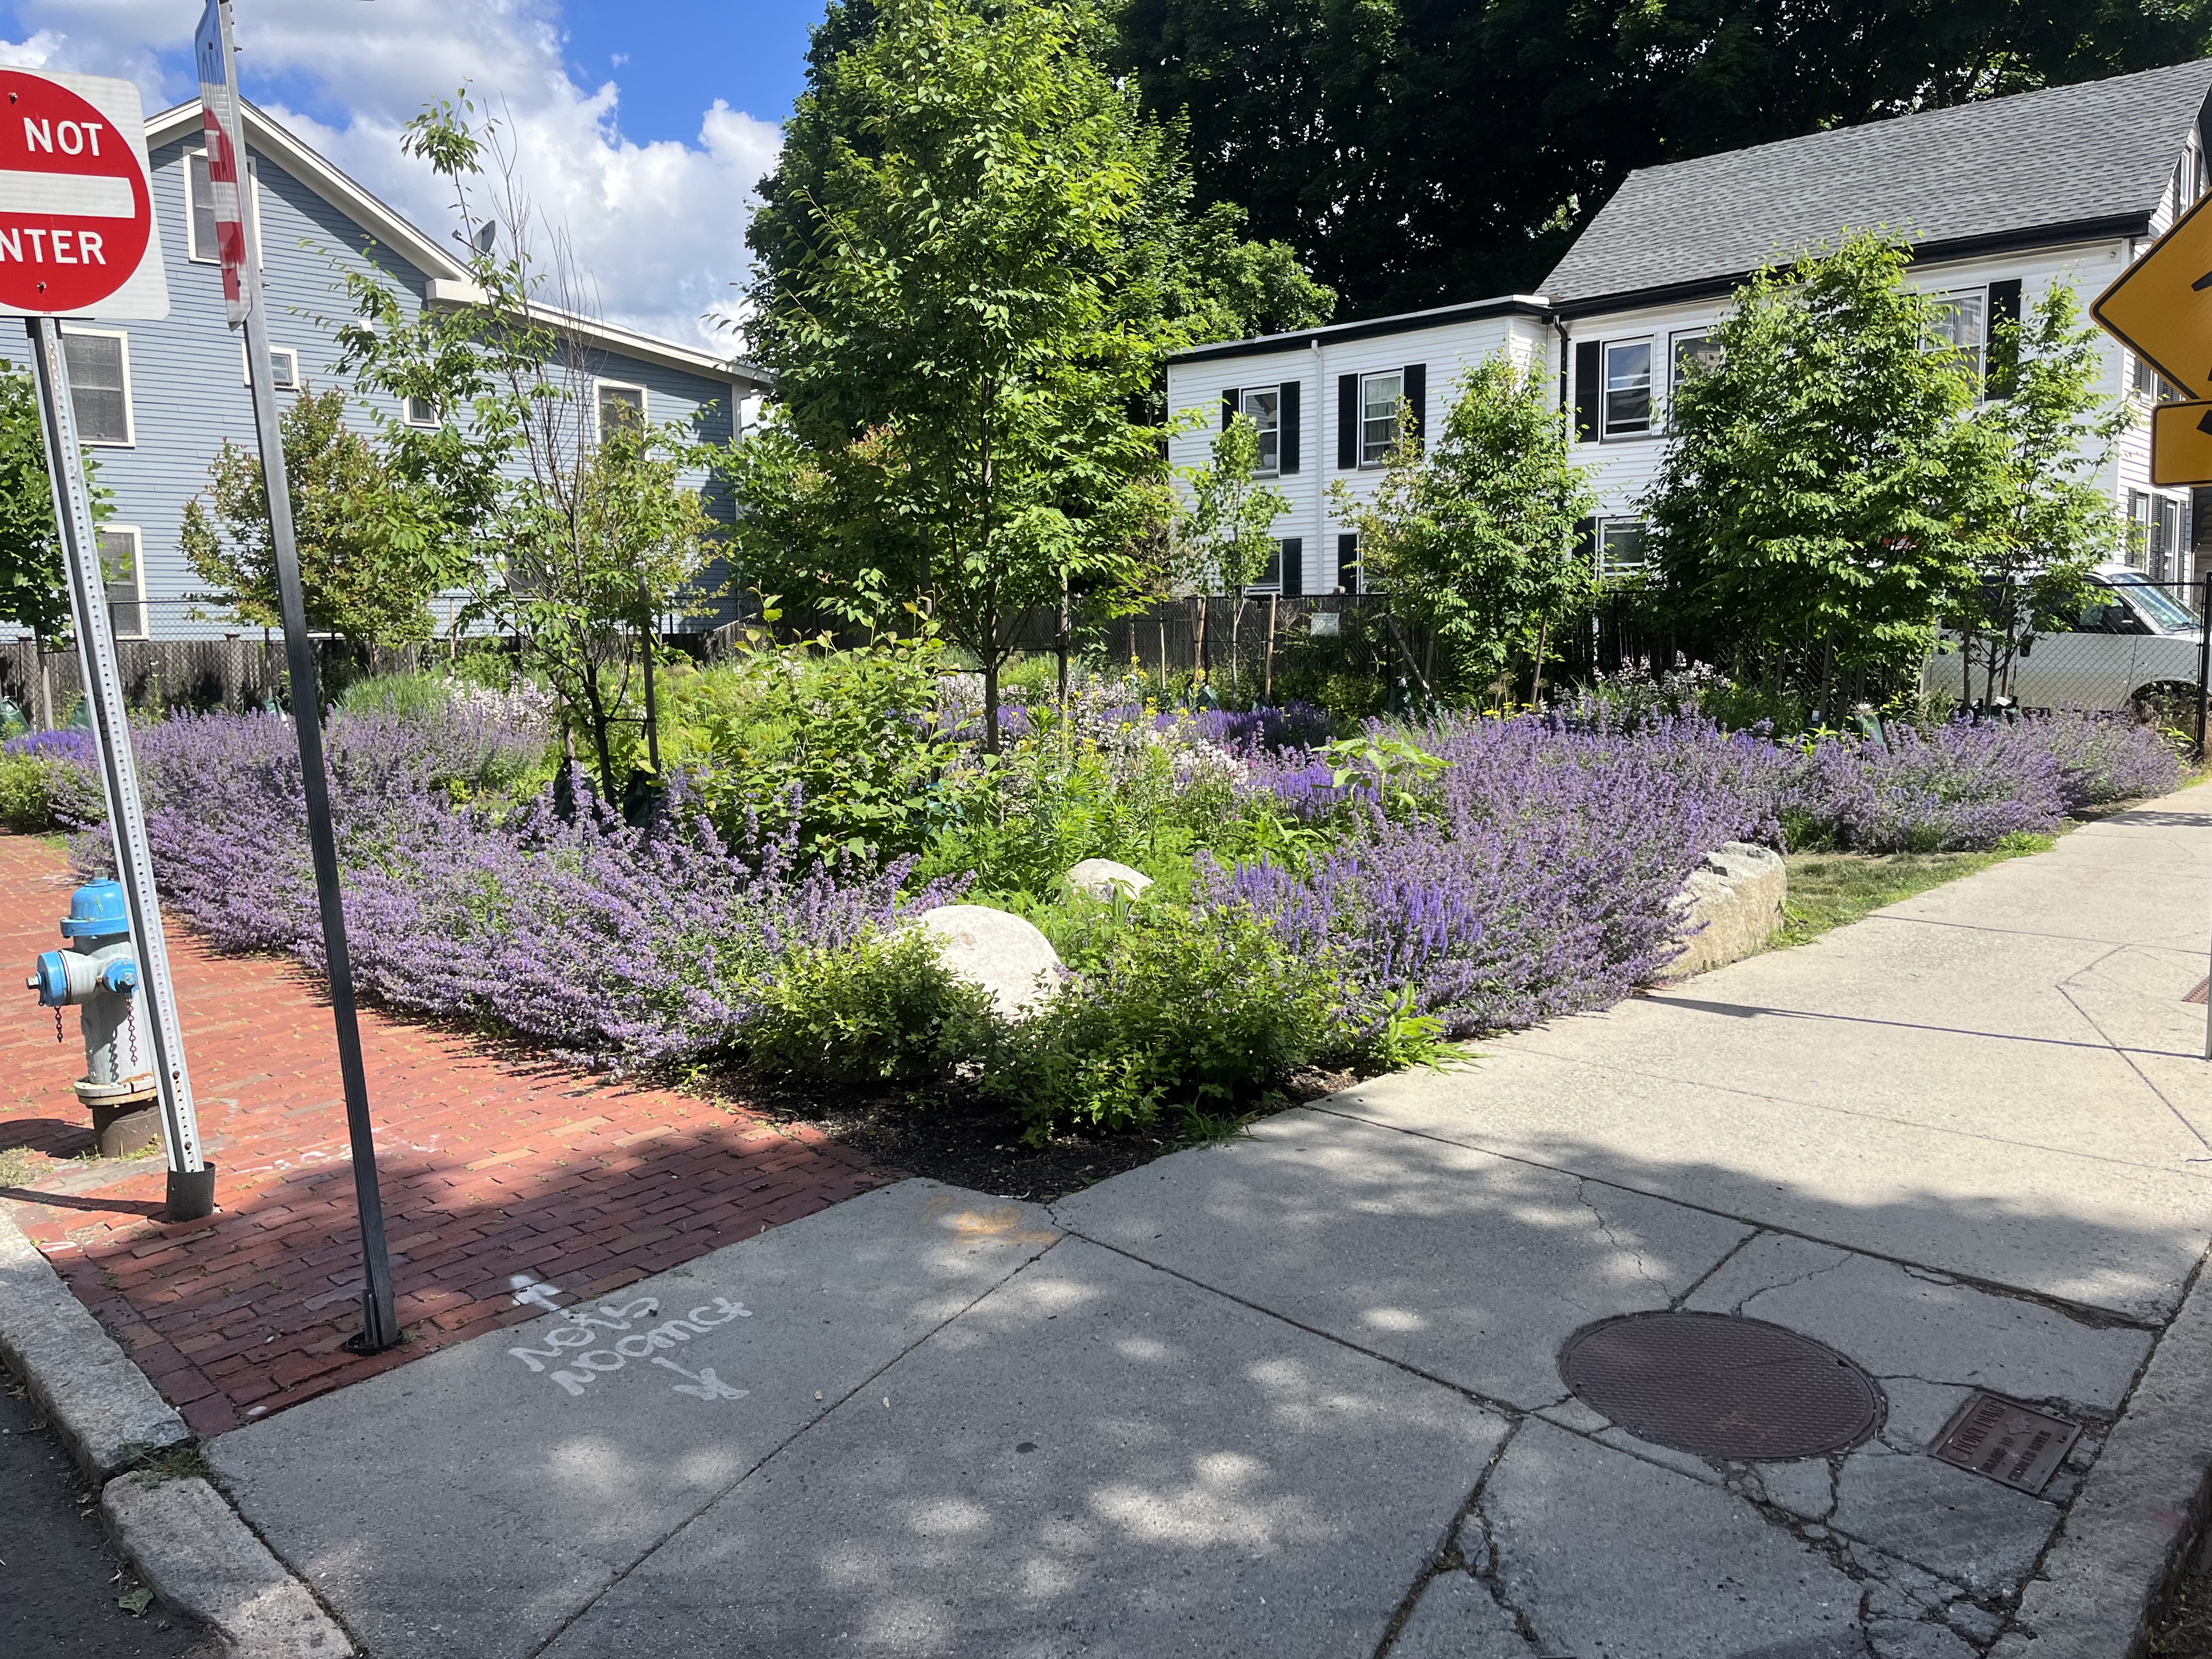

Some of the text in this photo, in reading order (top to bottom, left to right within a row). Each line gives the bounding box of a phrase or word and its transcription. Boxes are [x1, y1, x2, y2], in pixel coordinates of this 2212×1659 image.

[24, 117, 103, 156] NOT
[0, 228, 106, 265] NTER
[1973, 1400, 2007, 1429] DUMP
[1979, 1437, 2015, 1474] DRAINS TO
[2007, 1431, 2052, 1482] CHARLES RIVER
